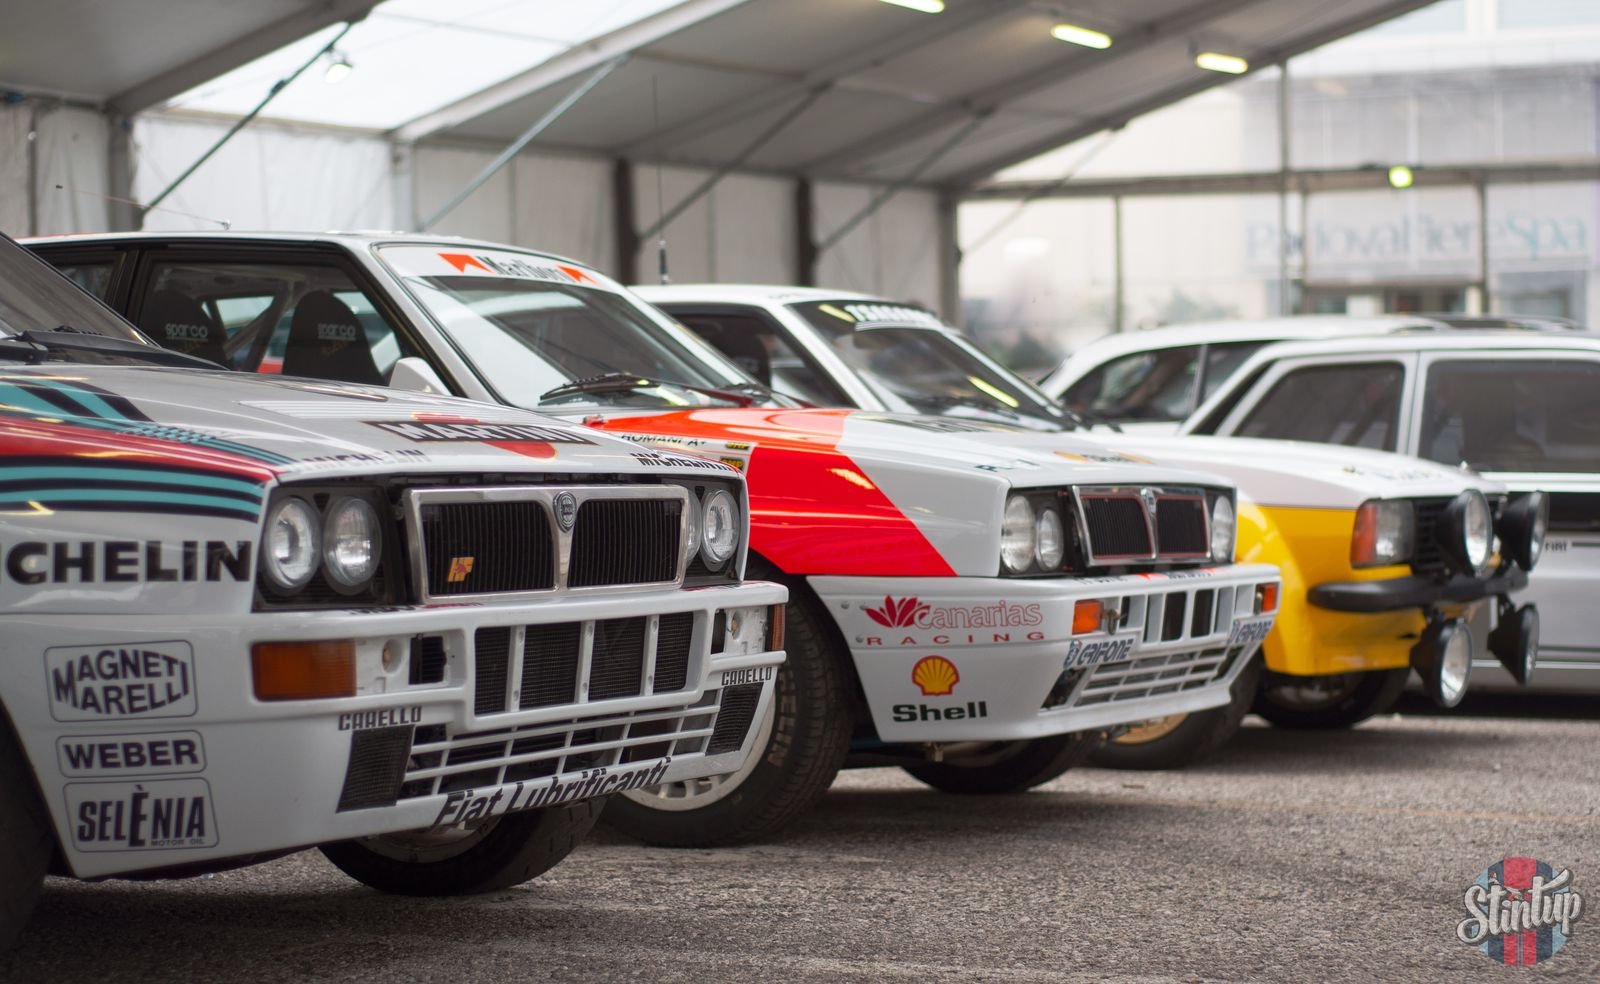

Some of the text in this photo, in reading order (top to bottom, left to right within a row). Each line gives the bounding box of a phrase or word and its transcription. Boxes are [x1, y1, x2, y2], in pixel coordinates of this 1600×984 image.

[165, 323, 208, 338] sparco
[317, 323, 356, 337] sparco
[379, 423, 587, 443] MARTINI
[0, 541, 252, 585] CHELIN
[913, 600, 1043, 629] Canarias
[867, 631, 1045, 645] RACING
[53, 649, 190, 698] MAGNETI
[53, 670, 190, 714] MARELLI
[893, 701, 987, 722] Shell
[64, 739, 199, 770] WEBER
[434, 756, 672, 828] Fiat Lubrificanti
[78, 784, 206, 847] SELÈNIA
